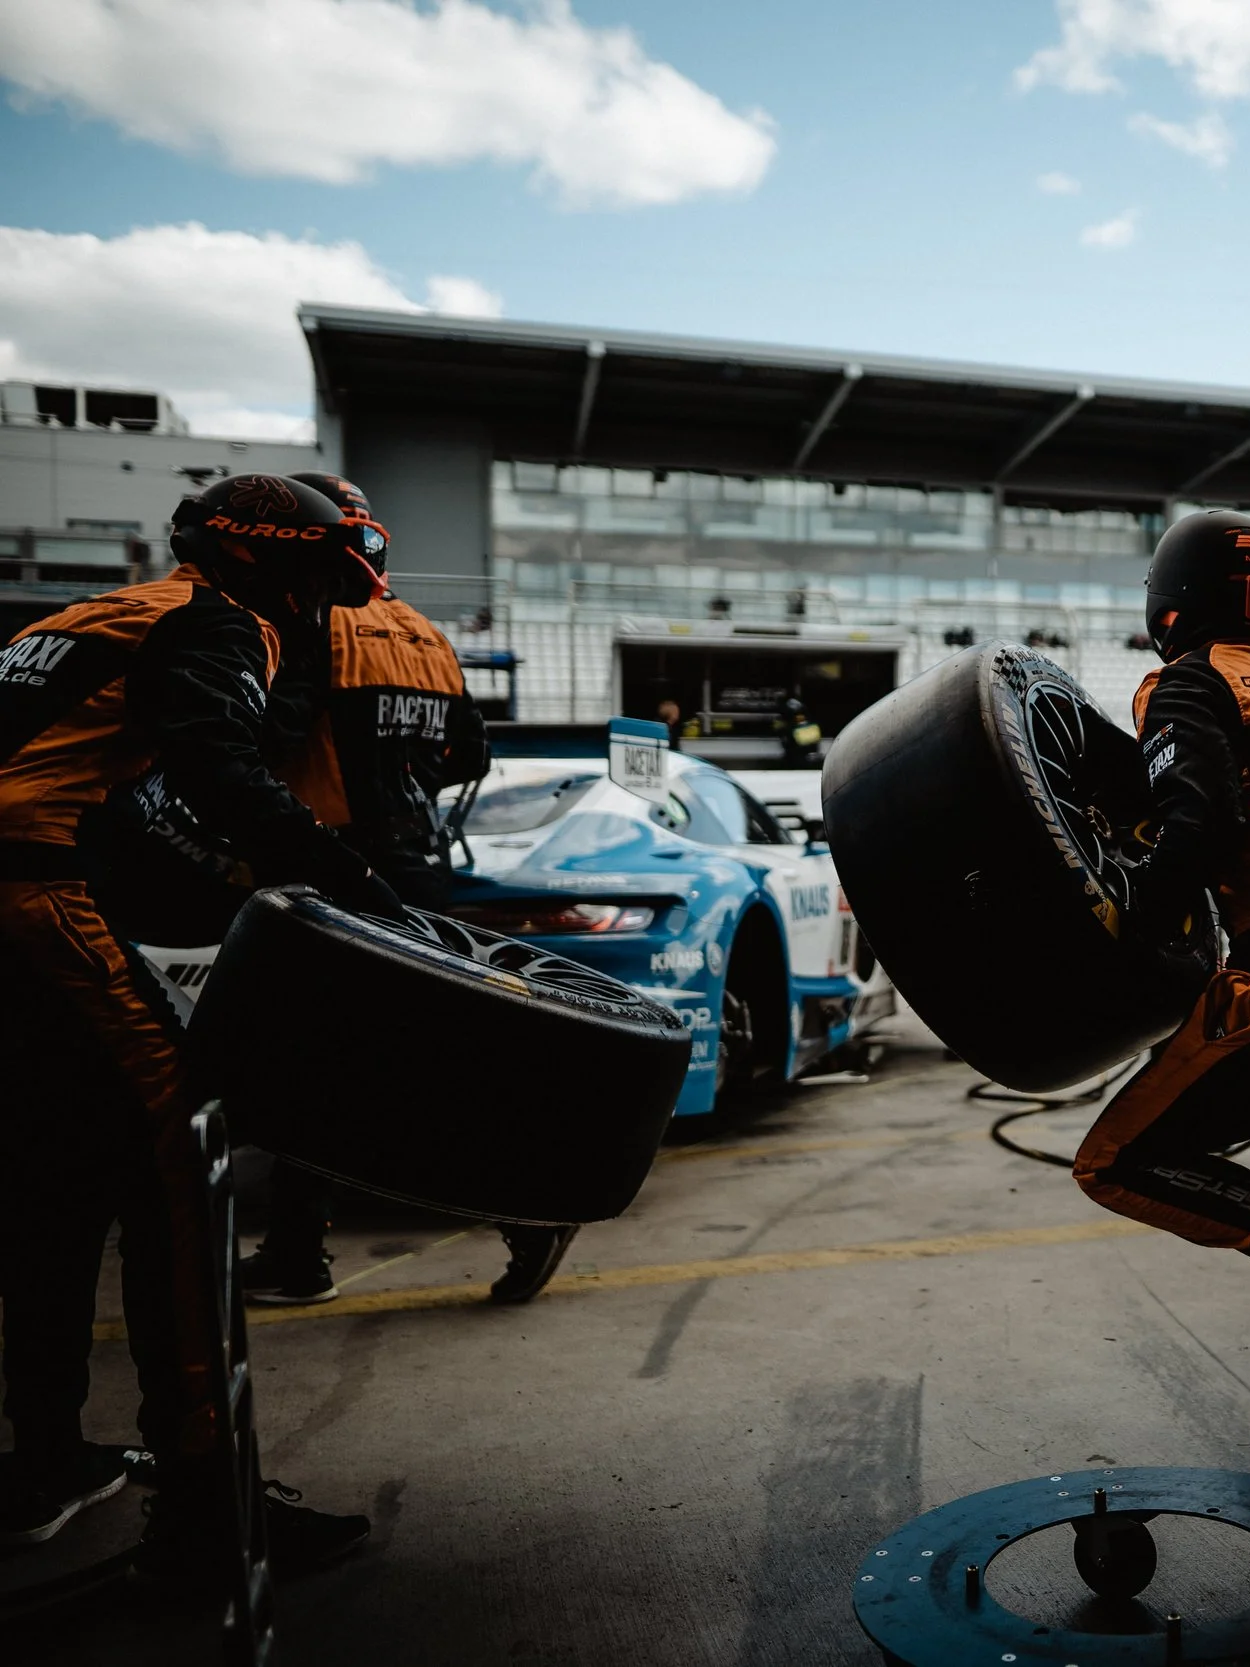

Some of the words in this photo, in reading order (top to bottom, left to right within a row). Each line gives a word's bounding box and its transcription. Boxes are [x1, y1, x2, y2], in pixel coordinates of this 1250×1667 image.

[1001, 700, 1084, 872] MICHELIN
[790, 885, 830, 921] KNAUS
[650, 950, 706, 973] KNAUS
